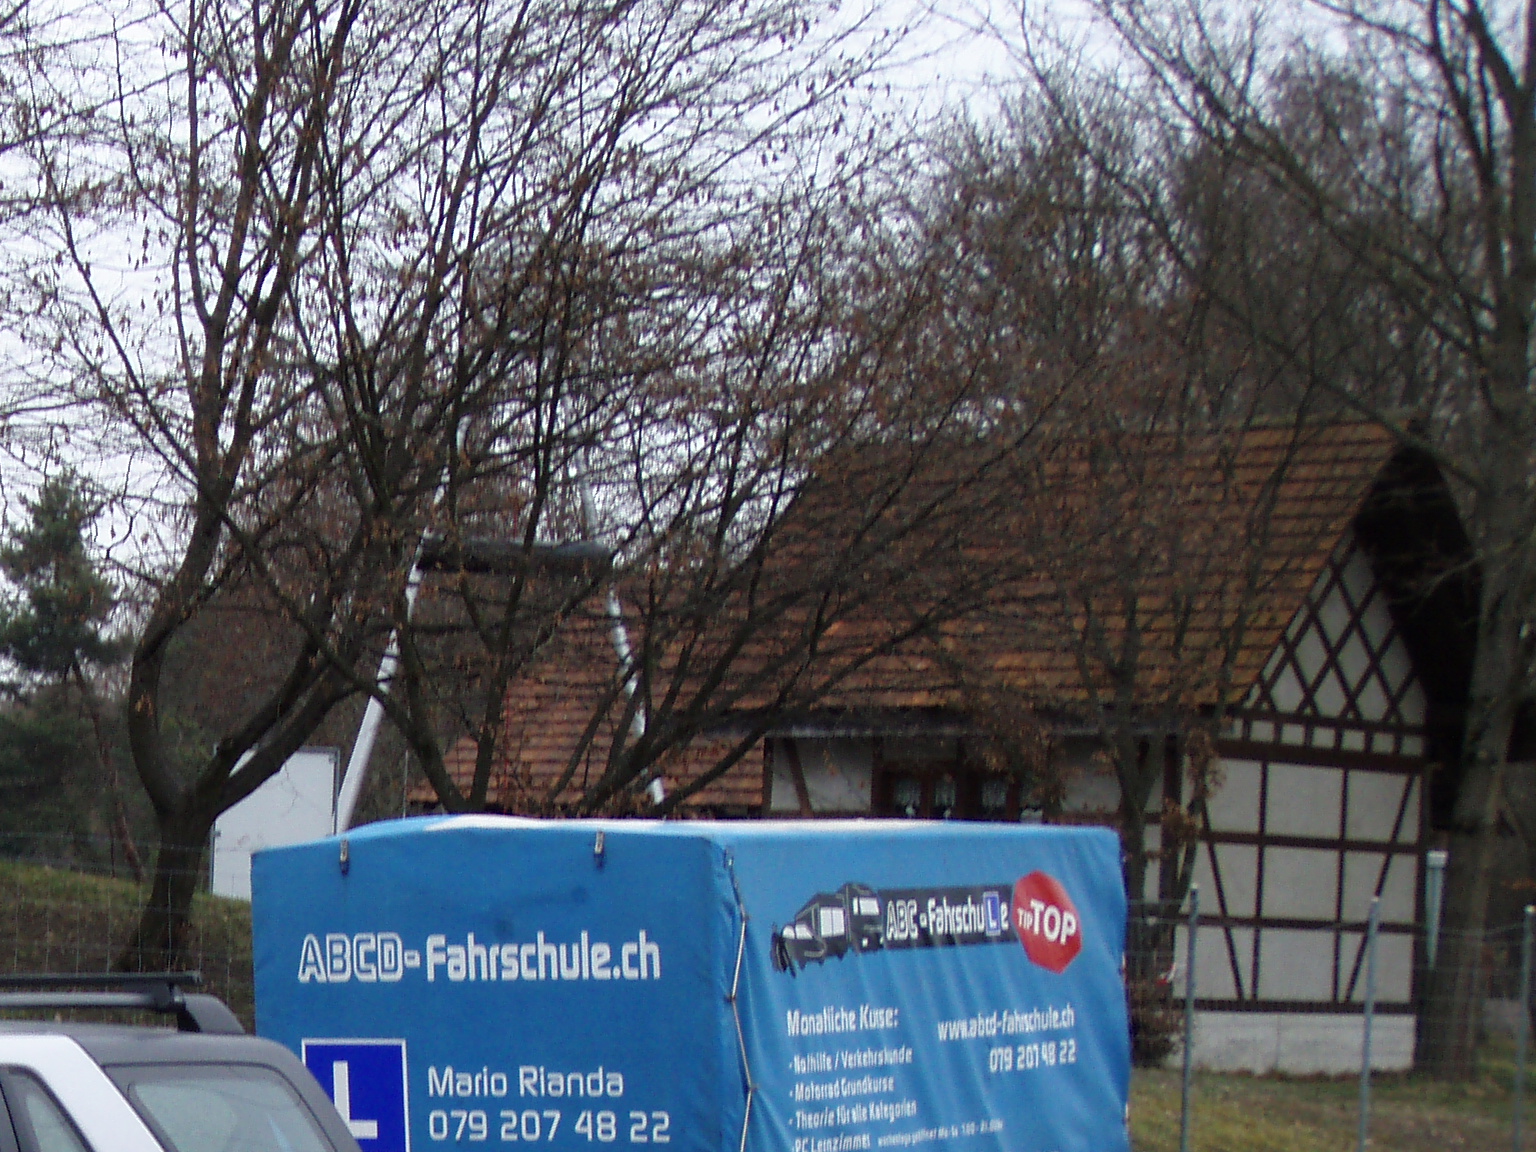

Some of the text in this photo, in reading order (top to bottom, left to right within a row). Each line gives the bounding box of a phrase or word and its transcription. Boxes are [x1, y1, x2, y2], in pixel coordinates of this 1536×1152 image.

[1030, 898, 1076, 945] TOP
[298, 929, 662, 983] ABCD-Fahrschule.ch
[787, 1005, 856, 1037] Monatliche
[989, 1038, 1077, 1073] 079 207 48 22
[428, 1066, 624, 1098] Mario Rianda
[795, 1075, 895, 1102] Motorrad Grundkurse
[332, 1060, 378, 1140] L
[796, 1106, 835, 1130] Theorie
[869, 1097, 917, 1123] Kategorien
[428, 1110, 672, 1142] 079 207 48 22
